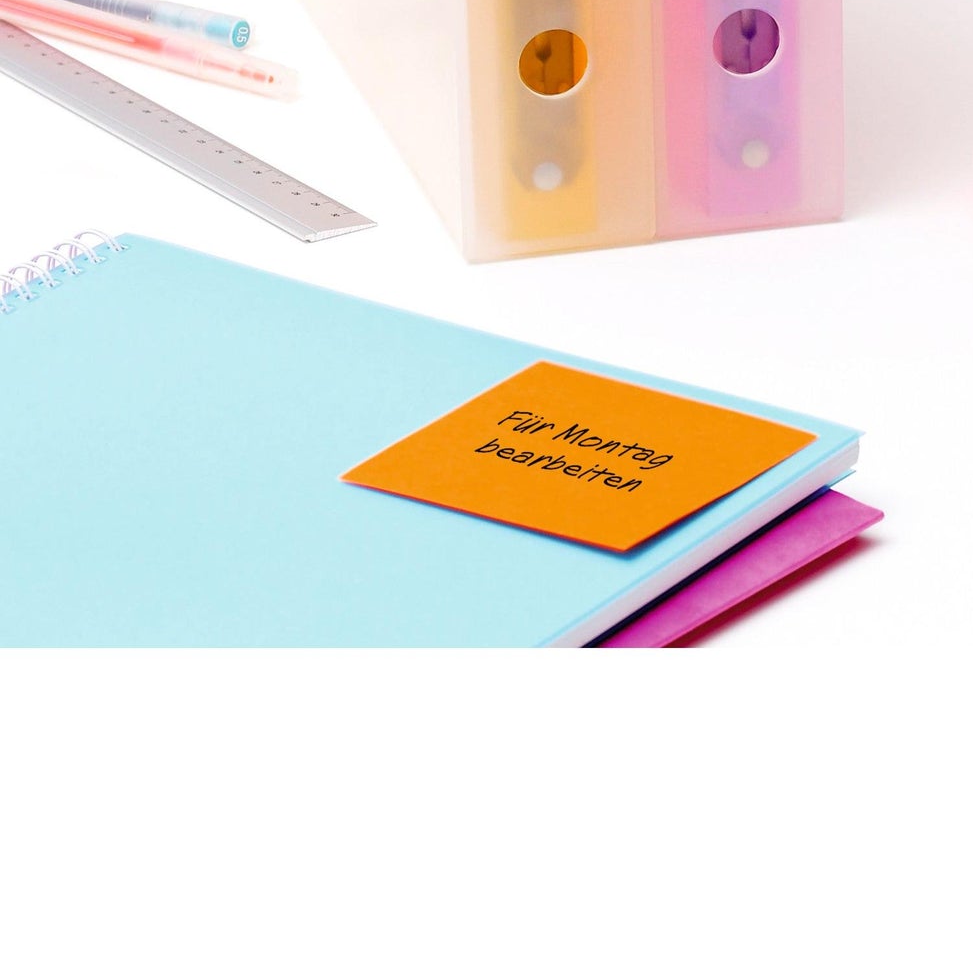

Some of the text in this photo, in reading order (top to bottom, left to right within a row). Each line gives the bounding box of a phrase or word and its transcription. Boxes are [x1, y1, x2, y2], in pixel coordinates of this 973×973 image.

[236, 26, 249, 43] 0.5
[474, 438, 643, 492] bearbeiten
[497, 410, 674, 470] Für Montag
